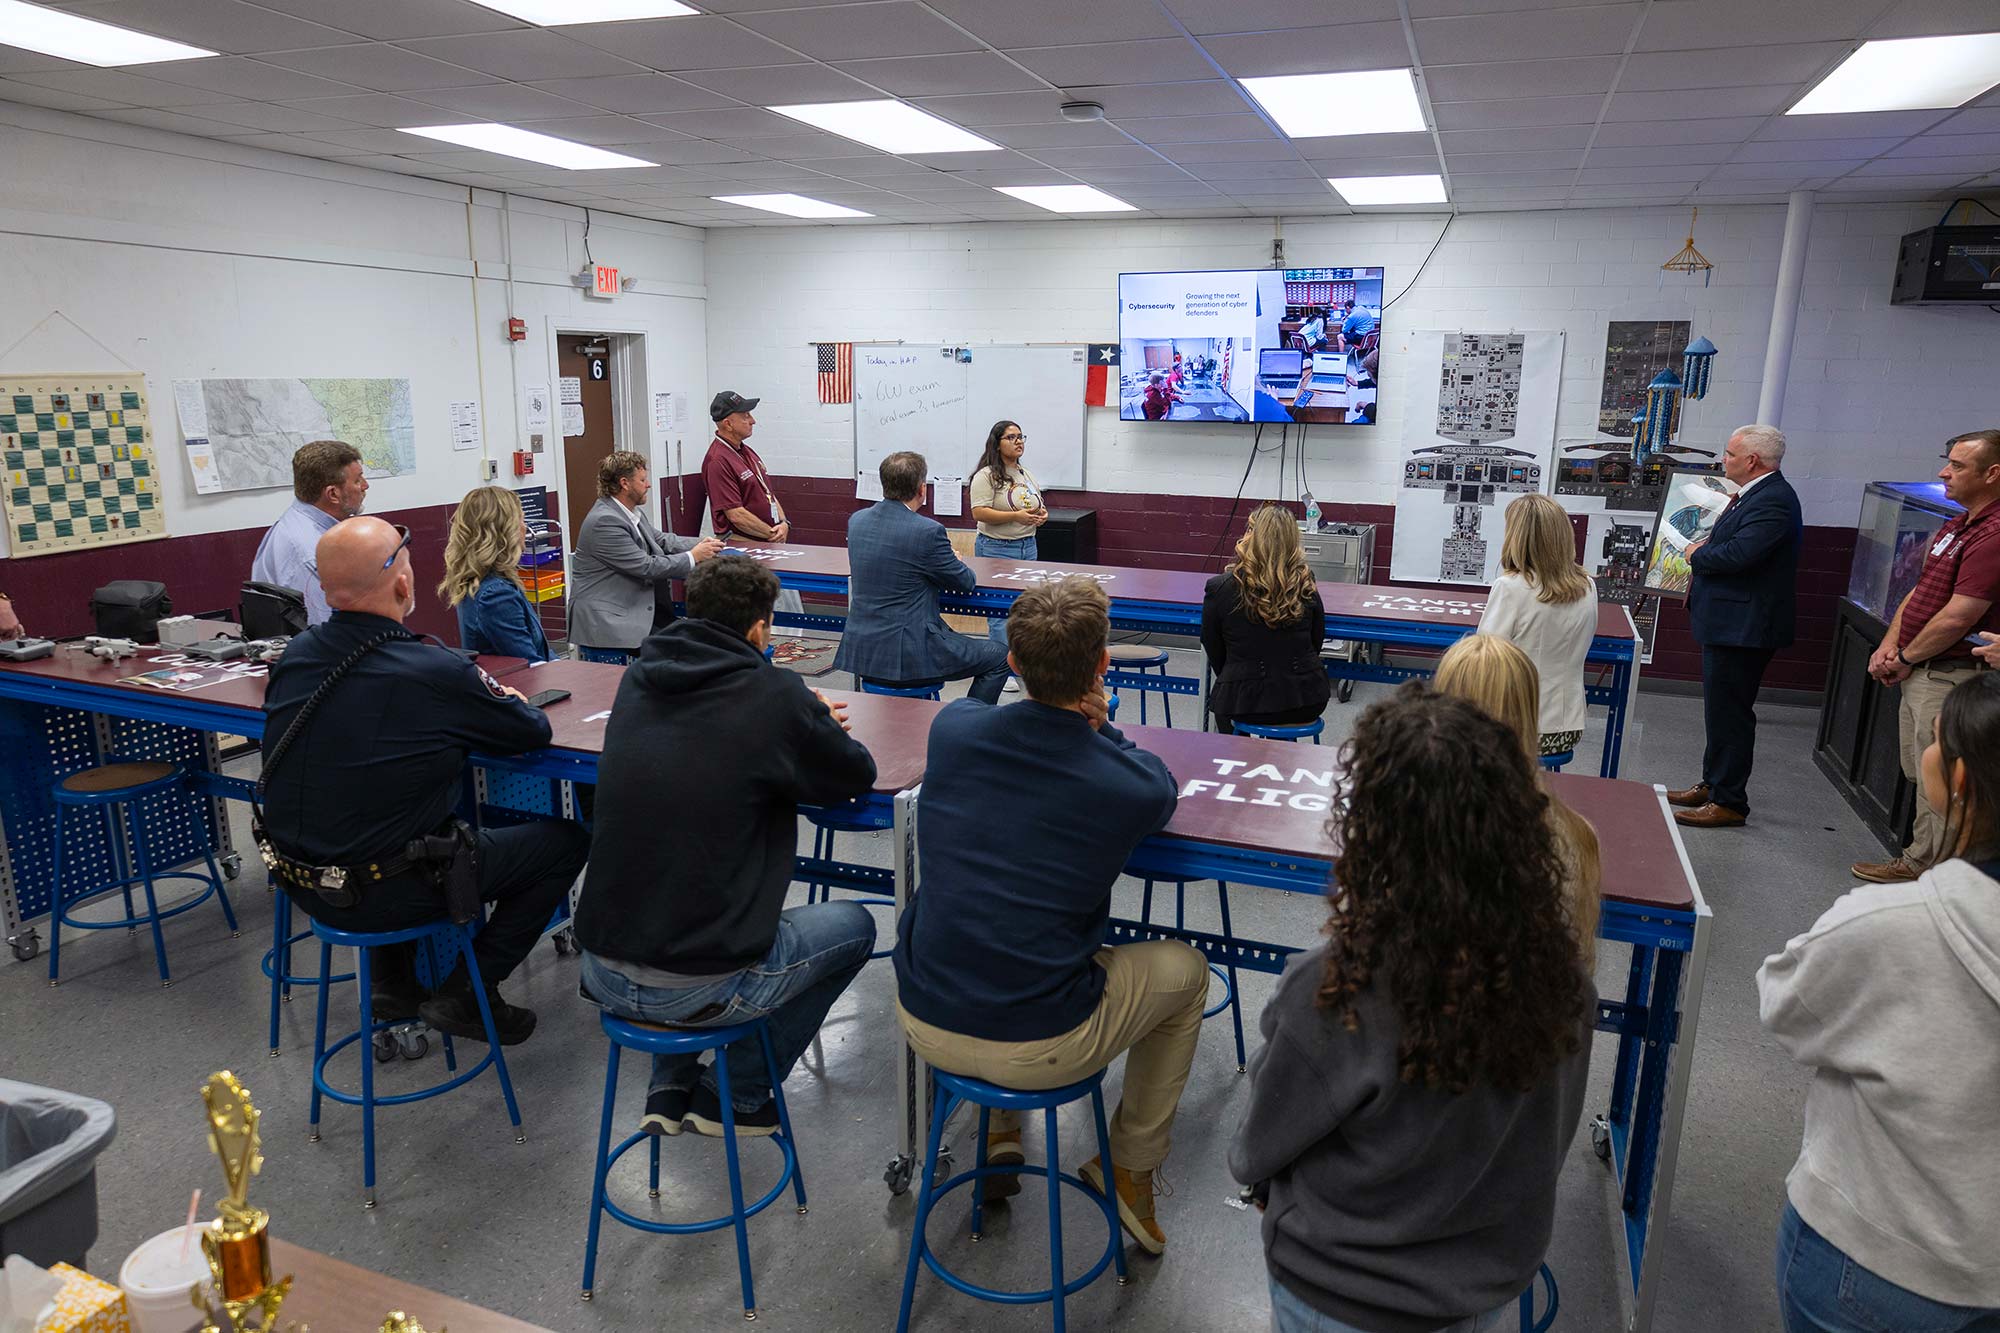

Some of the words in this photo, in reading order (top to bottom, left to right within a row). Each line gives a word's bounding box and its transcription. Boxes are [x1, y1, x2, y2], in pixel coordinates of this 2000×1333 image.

[597, 266, 618, 293] EXIT
[1185, 293, 1212, 301] Growing
[1128, 303, 1175, 311] Cybersecurity
[1229, 301, 1248, 309] cyber
[593, 359, 602, 379] 6
[909, 381, 941, 395] exam
[1014, 567, 1116, 580] TANGO
[1362, 601, 1485, 616] FLIGH
[1212, 758, 1334, 787] TAN
[1181, 779, 1330, 811] FLIG
